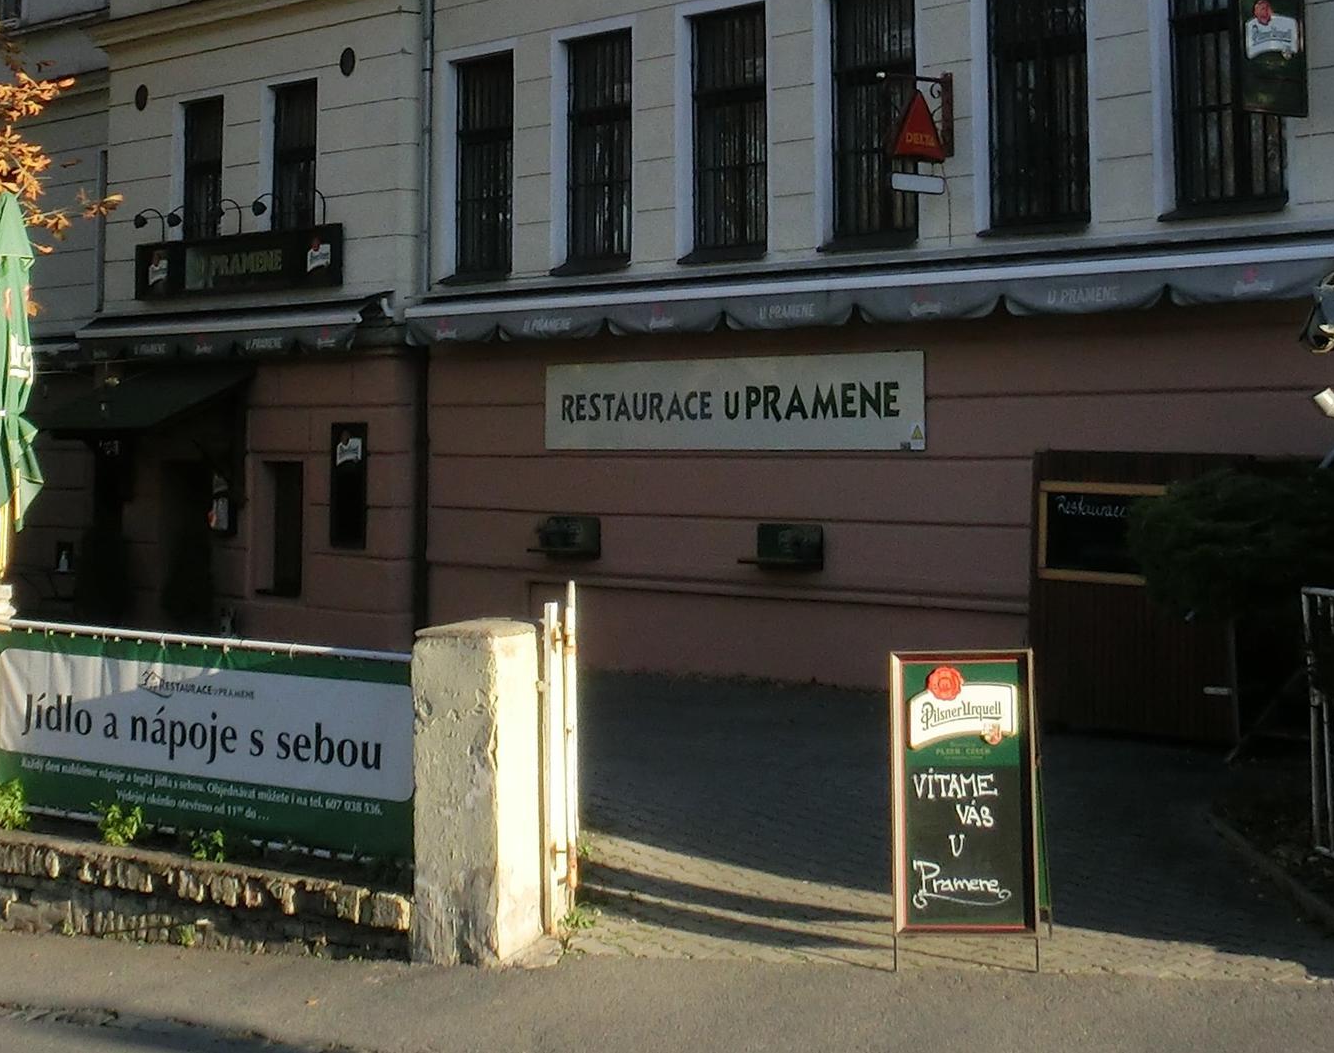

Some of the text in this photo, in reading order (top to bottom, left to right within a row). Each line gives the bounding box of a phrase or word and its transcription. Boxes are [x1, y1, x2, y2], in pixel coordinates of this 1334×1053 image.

[1061, 285, 1120, 304] PRAMENE
[769, 303, 815, 319] PRAMENE
[561, 381, 901, 424] RESTAURACE U PRAMENE
[920, 700, 1002, 731] Pilsner Urquell
[21, 692, 382, 771] Jídlo a nápoje s sebou
[913, 767, 998, 799] VÍTAME
[956, 799, 994, 828] VÁS
[948, 834, 965, 857] U
[912, 859, 1002, 903] Pramene
